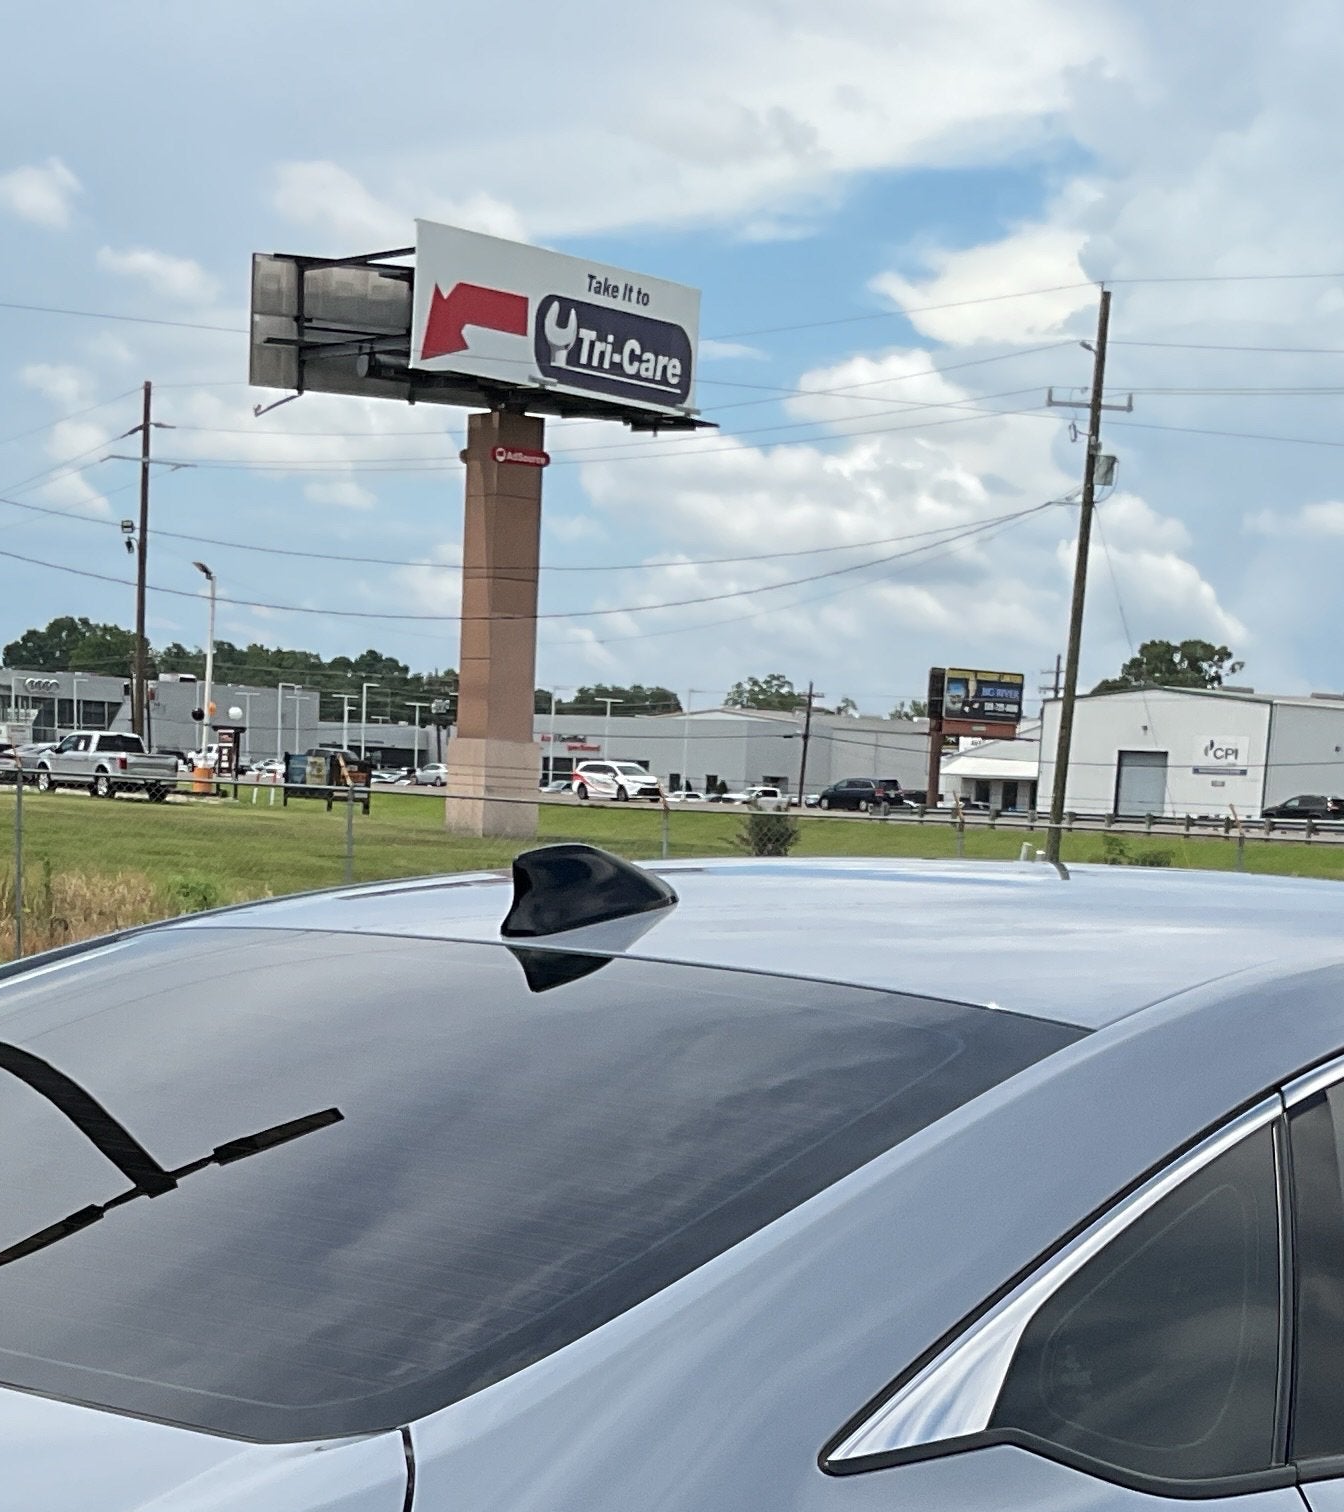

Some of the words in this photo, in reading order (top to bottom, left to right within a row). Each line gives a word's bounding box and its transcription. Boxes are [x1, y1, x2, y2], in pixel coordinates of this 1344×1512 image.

[587, 273, 619, 299] Take
[622, 283, 633, 303] It
[637, 287, 650, 306] to
[578, 328, 682, 385] Tri-Care
[1213, 747, 1239, 760] CPI
